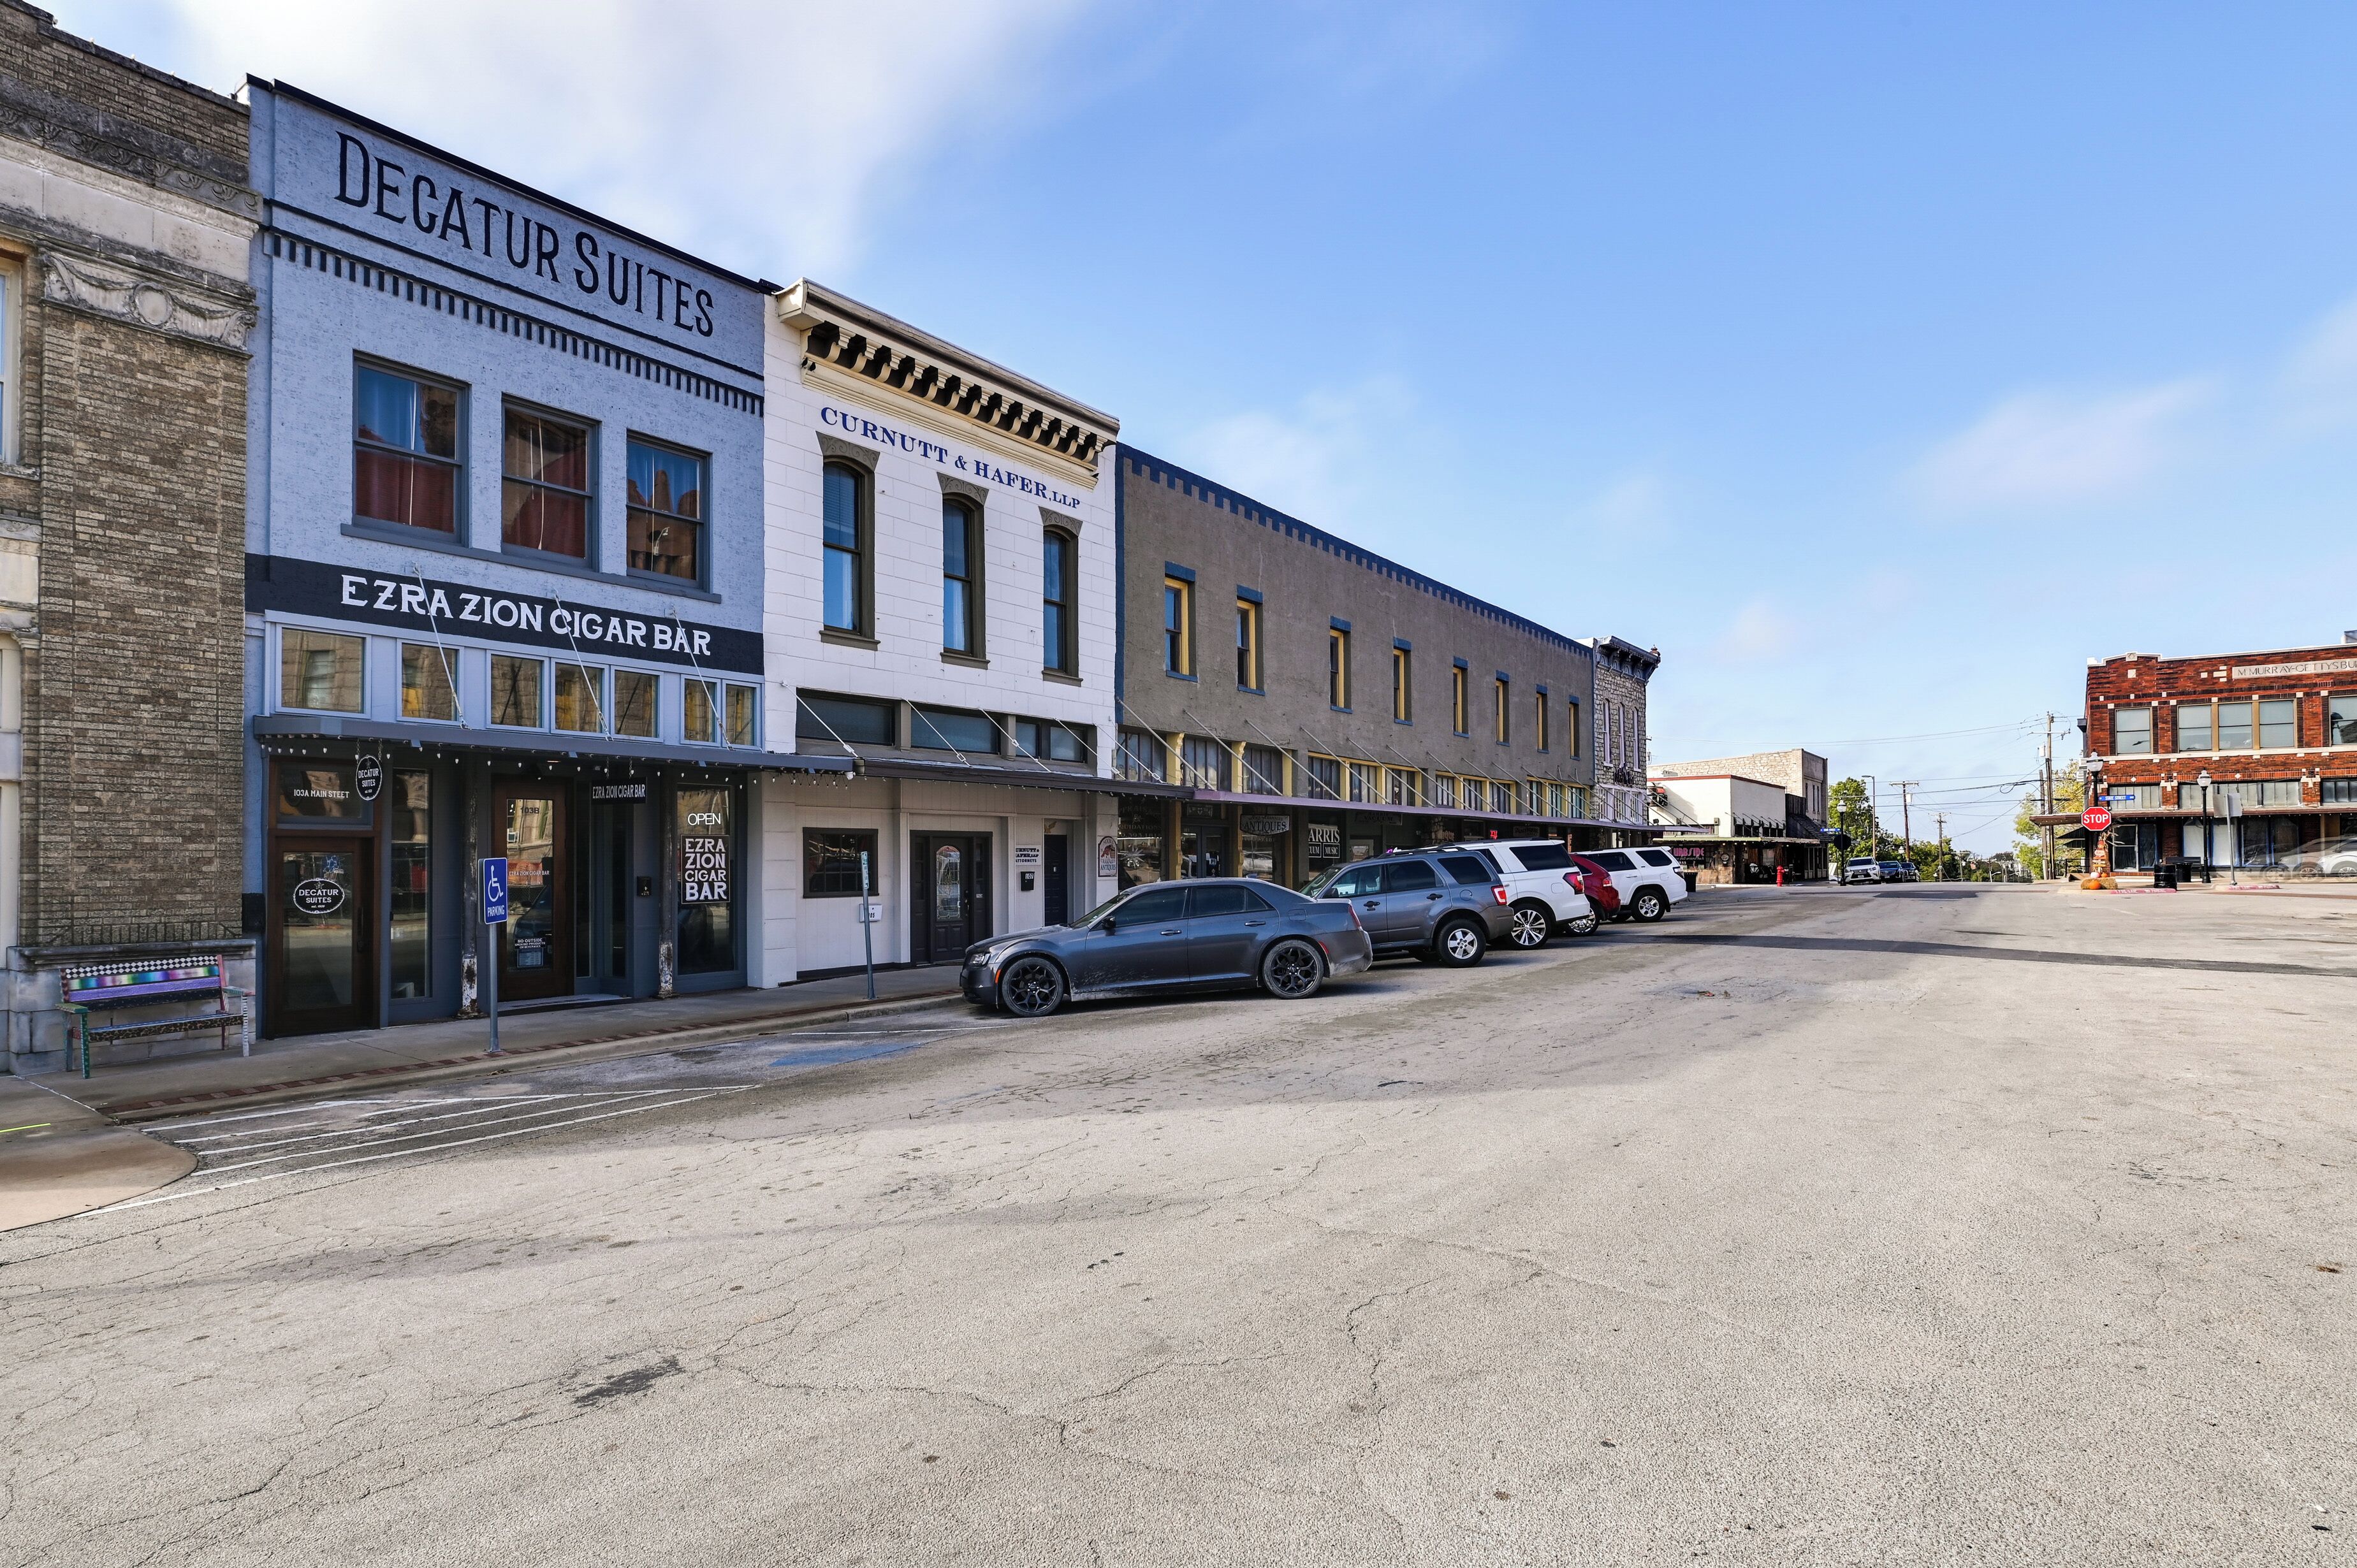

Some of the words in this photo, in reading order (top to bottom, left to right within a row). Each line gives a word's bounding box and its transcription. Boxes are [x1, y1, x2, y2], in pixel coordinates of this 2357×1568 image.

[334, 130, 560, 284] DECATUR
[574, 231, 714, 337] SUITES
[821, 407, 948, 465] CURNUTT
[954, 455, 968, 471] &
[340, 574, 454, 618] EZRA
[458, 593, 543, 632] ZION
[550, 608, 646, 648] CIGAR
[652, 623, 711, 656] BAR
[358, 768, 379, 778] DECATUR
[361, 779, 376, 787] SUITES
[592, 786, 605, 799] EZRA
[606, 785, 617, 798] ZION
[618, 785, 634, 798] CIGAR
[634, 784, 645, 797] BAR
[687, 813, 721, 825] OPEN
[2083, 814, 2109, 824] STOP
[1244, 821, 1286, 834] ANTIQUES
[1308, 828, 1339, 843] ARRIS
[685, 838, 726, 853] EZRA
[1309, 846, 1320, 854] UUM
[1325, 846, 1338, 855] MUSIC
[685, 853, 726, 869] ZION
[685, 869, 726, 882] CIGAR
[685, 882, 727, 901] BAR
[487, 905, 505, 917] PARKING
